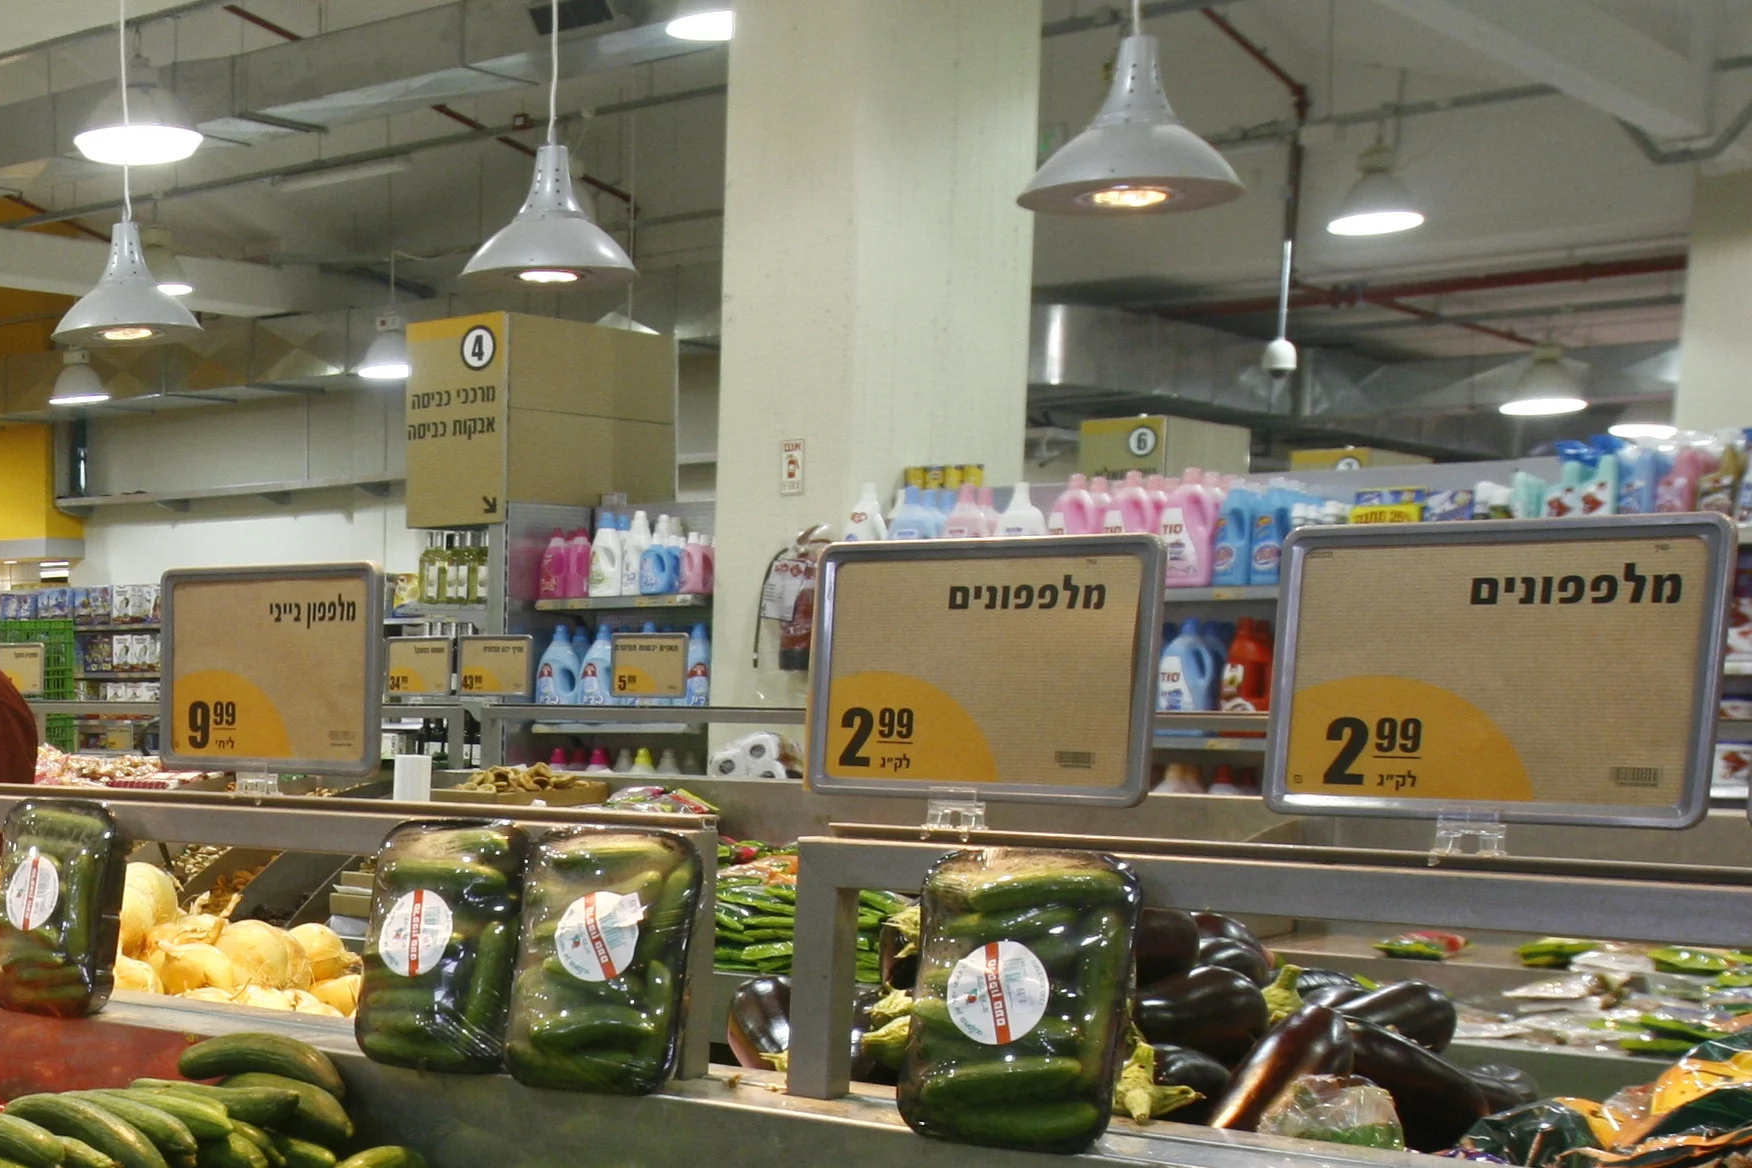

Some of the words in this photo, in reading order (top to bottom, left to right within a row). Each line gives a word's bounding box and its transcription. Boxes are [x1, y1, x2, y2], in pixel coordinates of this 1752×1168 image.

[471, 334, 485, 361] 4
[411, 390, 451, 410] כביסה
[456, 385, 496, 405] מרככי
[408, 420, 447, 440] כביסה
[452, 416, 496, 440] אבקות
[1136, 432, 1148, 451] 6
[948, 574, 1106, 610] מלפפונים
[1470, 562, 1682, 605] מלפפונים
[269, 602, 301, 622] בייבי
[306, 593, 357, 629] מלפפון
[389, 676, 401, 691] 34
[461, 675, 474, 690] 43
[618, 675, 627, 691] 5
[188, 701, 211, 749] 9
[213, 701, 236, 726] 99
[838, 707, 874, 767] 2
[878, 708, 914, 739] 99
[1322, 717, 1369, 786] 2
[1375, 717, 1422, 754] 99
[880, 754, 911, 772] לק"ג
[1376, 770, 1417, 792] לק"ג
